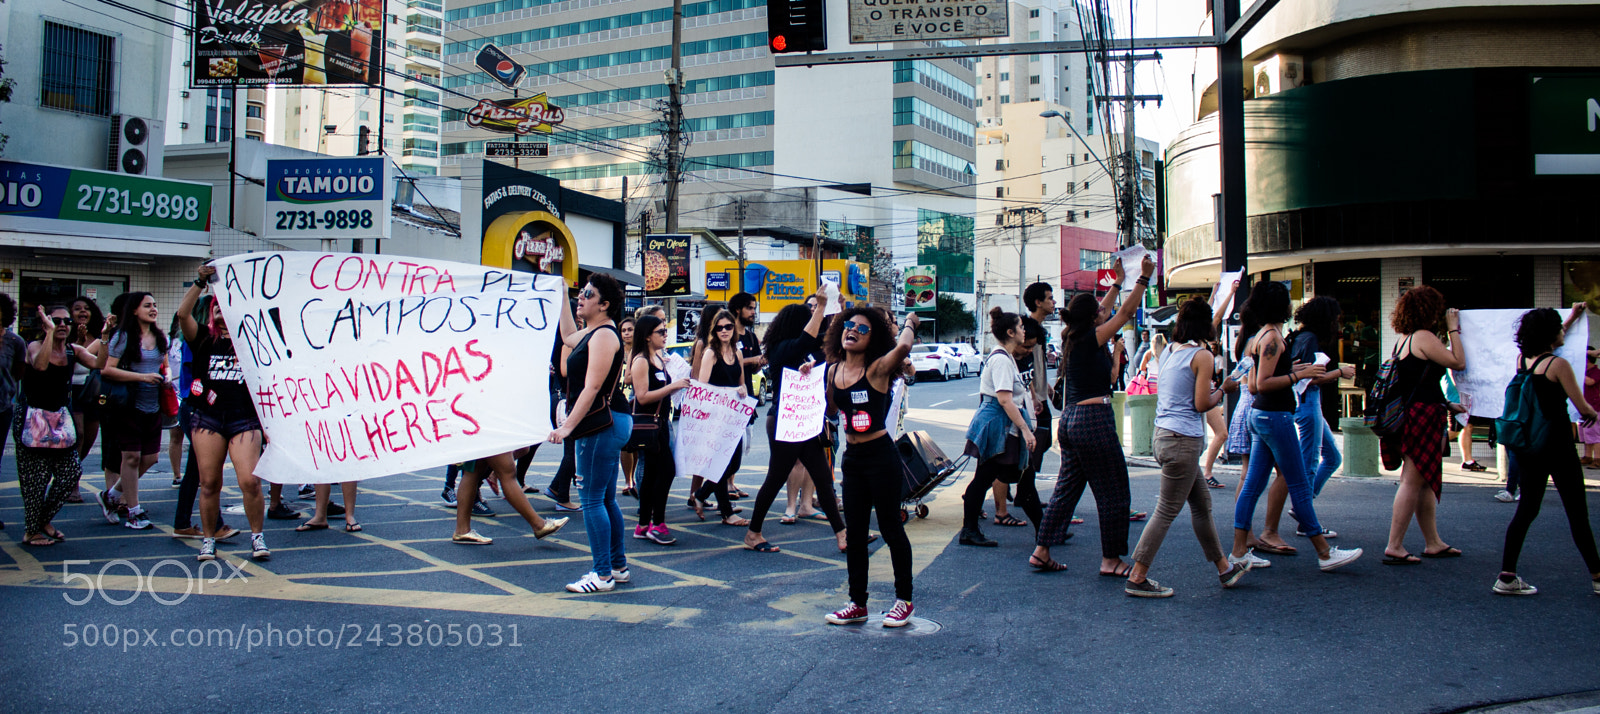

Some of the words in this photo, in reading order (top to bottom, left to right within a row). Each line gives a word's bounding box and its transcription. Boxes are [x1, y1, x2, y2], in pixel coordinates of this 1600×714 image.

[870, 10, 883, 20] O
[889, 5, 988, 20] TRÂNSITO
[200, 26, 261, 44] Drinks
[894, 21, 905, 35] É
[911, 18, 965, 34] VOCÊ
[468, 99, 527, 127] Pizza
[517, 102, 564, 133] Bus
[494, 148, 540, 156] 2735-3320
[283, 167, 374, 175] DROGARIAS
[0, 181, 42, 207] IO
[284, 175, 375, 194] TAMOIO
[77, 184, 199, 221] 2731-9898
[484, 188, 503, 209] FATIAS
[501, 186, 507, 197] &
[507, 185, 532, 197] DELIVERY
[275, 209, 374, 231] 2731-9898
[515, 231, 546, 260] Pizza
[539, 237, 564, 272] Bus
[225, 254, 284, 306] ATO
[310, 255, 456, 295] CONTRA
[481, 270, 556, 293] PEC
[766, 270, 796, 282] Casa
[766, 283, 805, 295] Filtros
[238, 307, 292, 368] 181!
[300, 296, 553, 350] CAMPOS-RJ
[305, 393, 480, 470] MULHERES
